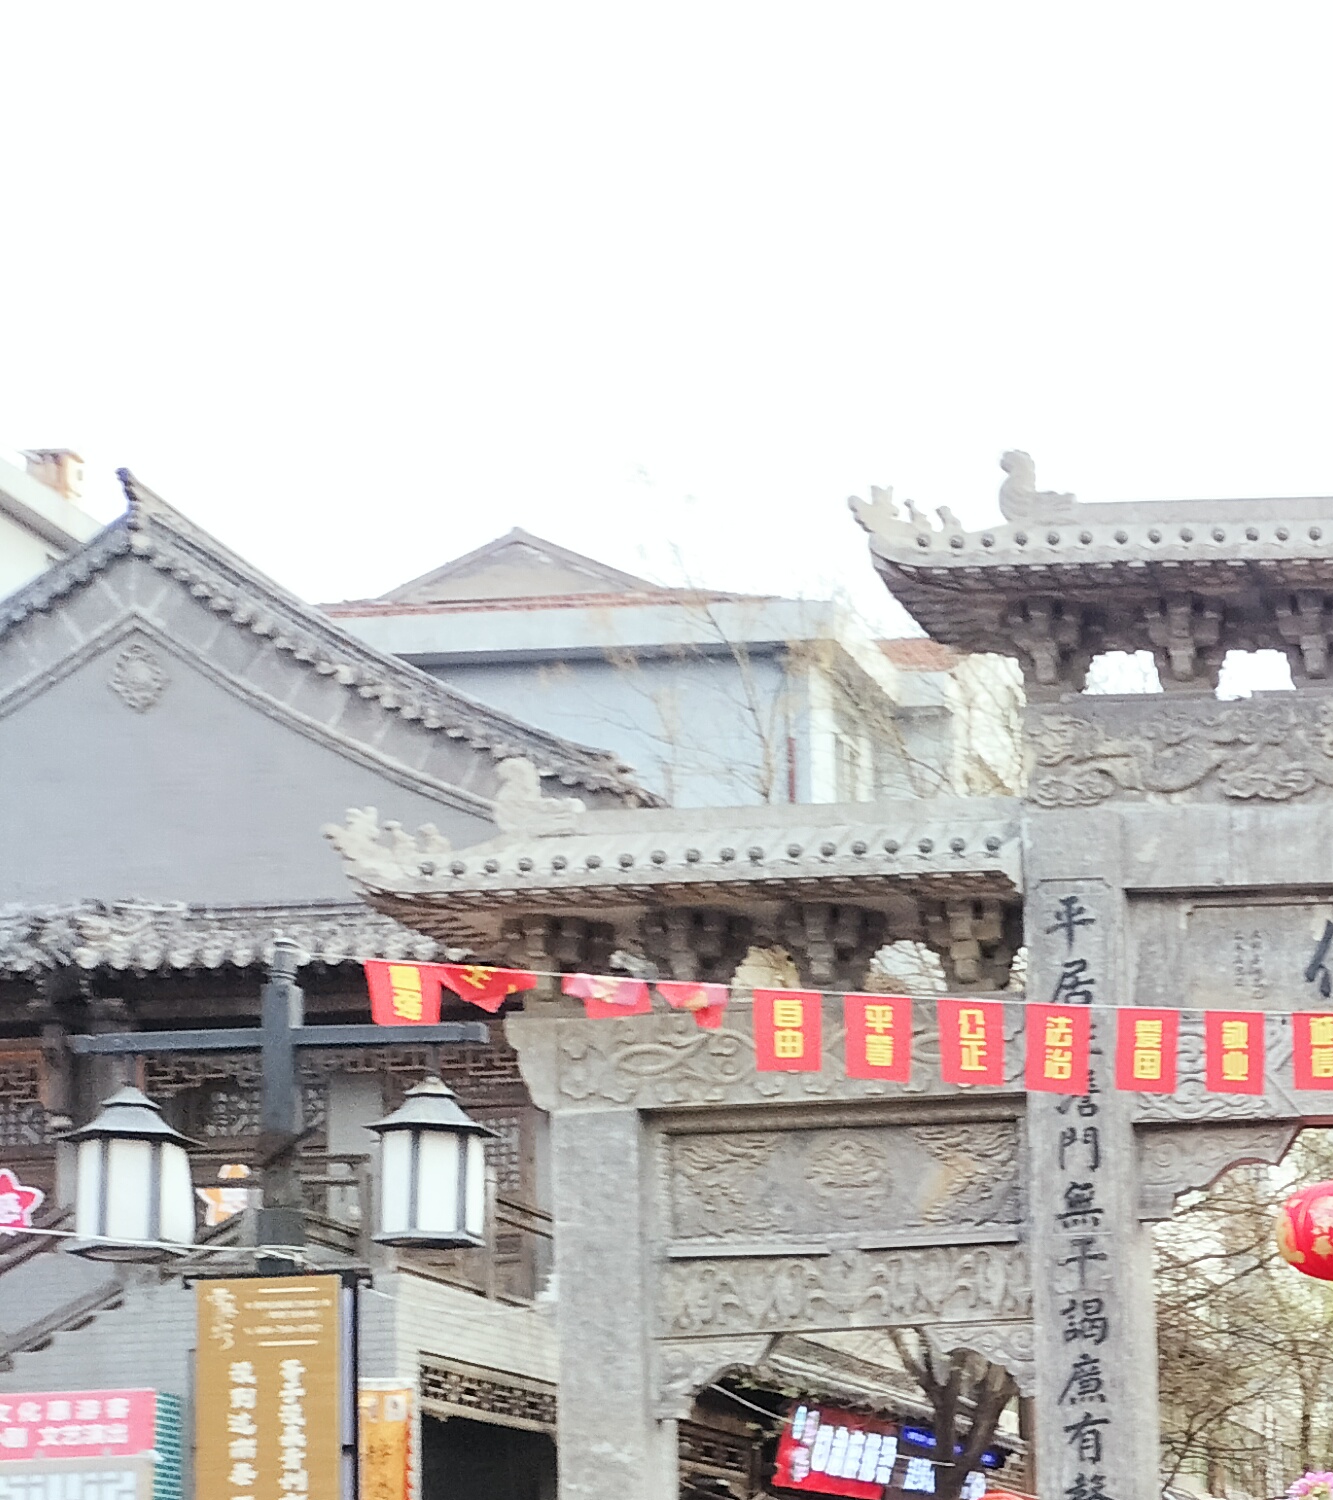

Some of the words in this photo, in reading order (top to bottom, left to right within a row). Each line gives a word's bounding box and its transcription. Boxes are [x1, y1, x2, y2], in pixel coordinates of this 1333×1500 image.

[774, 1000, 803, 1058] 自由
[865, 1004, 893, 1067] 平等
[959, 1009, 987, 1070] 公正
[1044, 1016, 1073, 1079] 法治
[1133, 1020, 1161, 1079] 爱国
